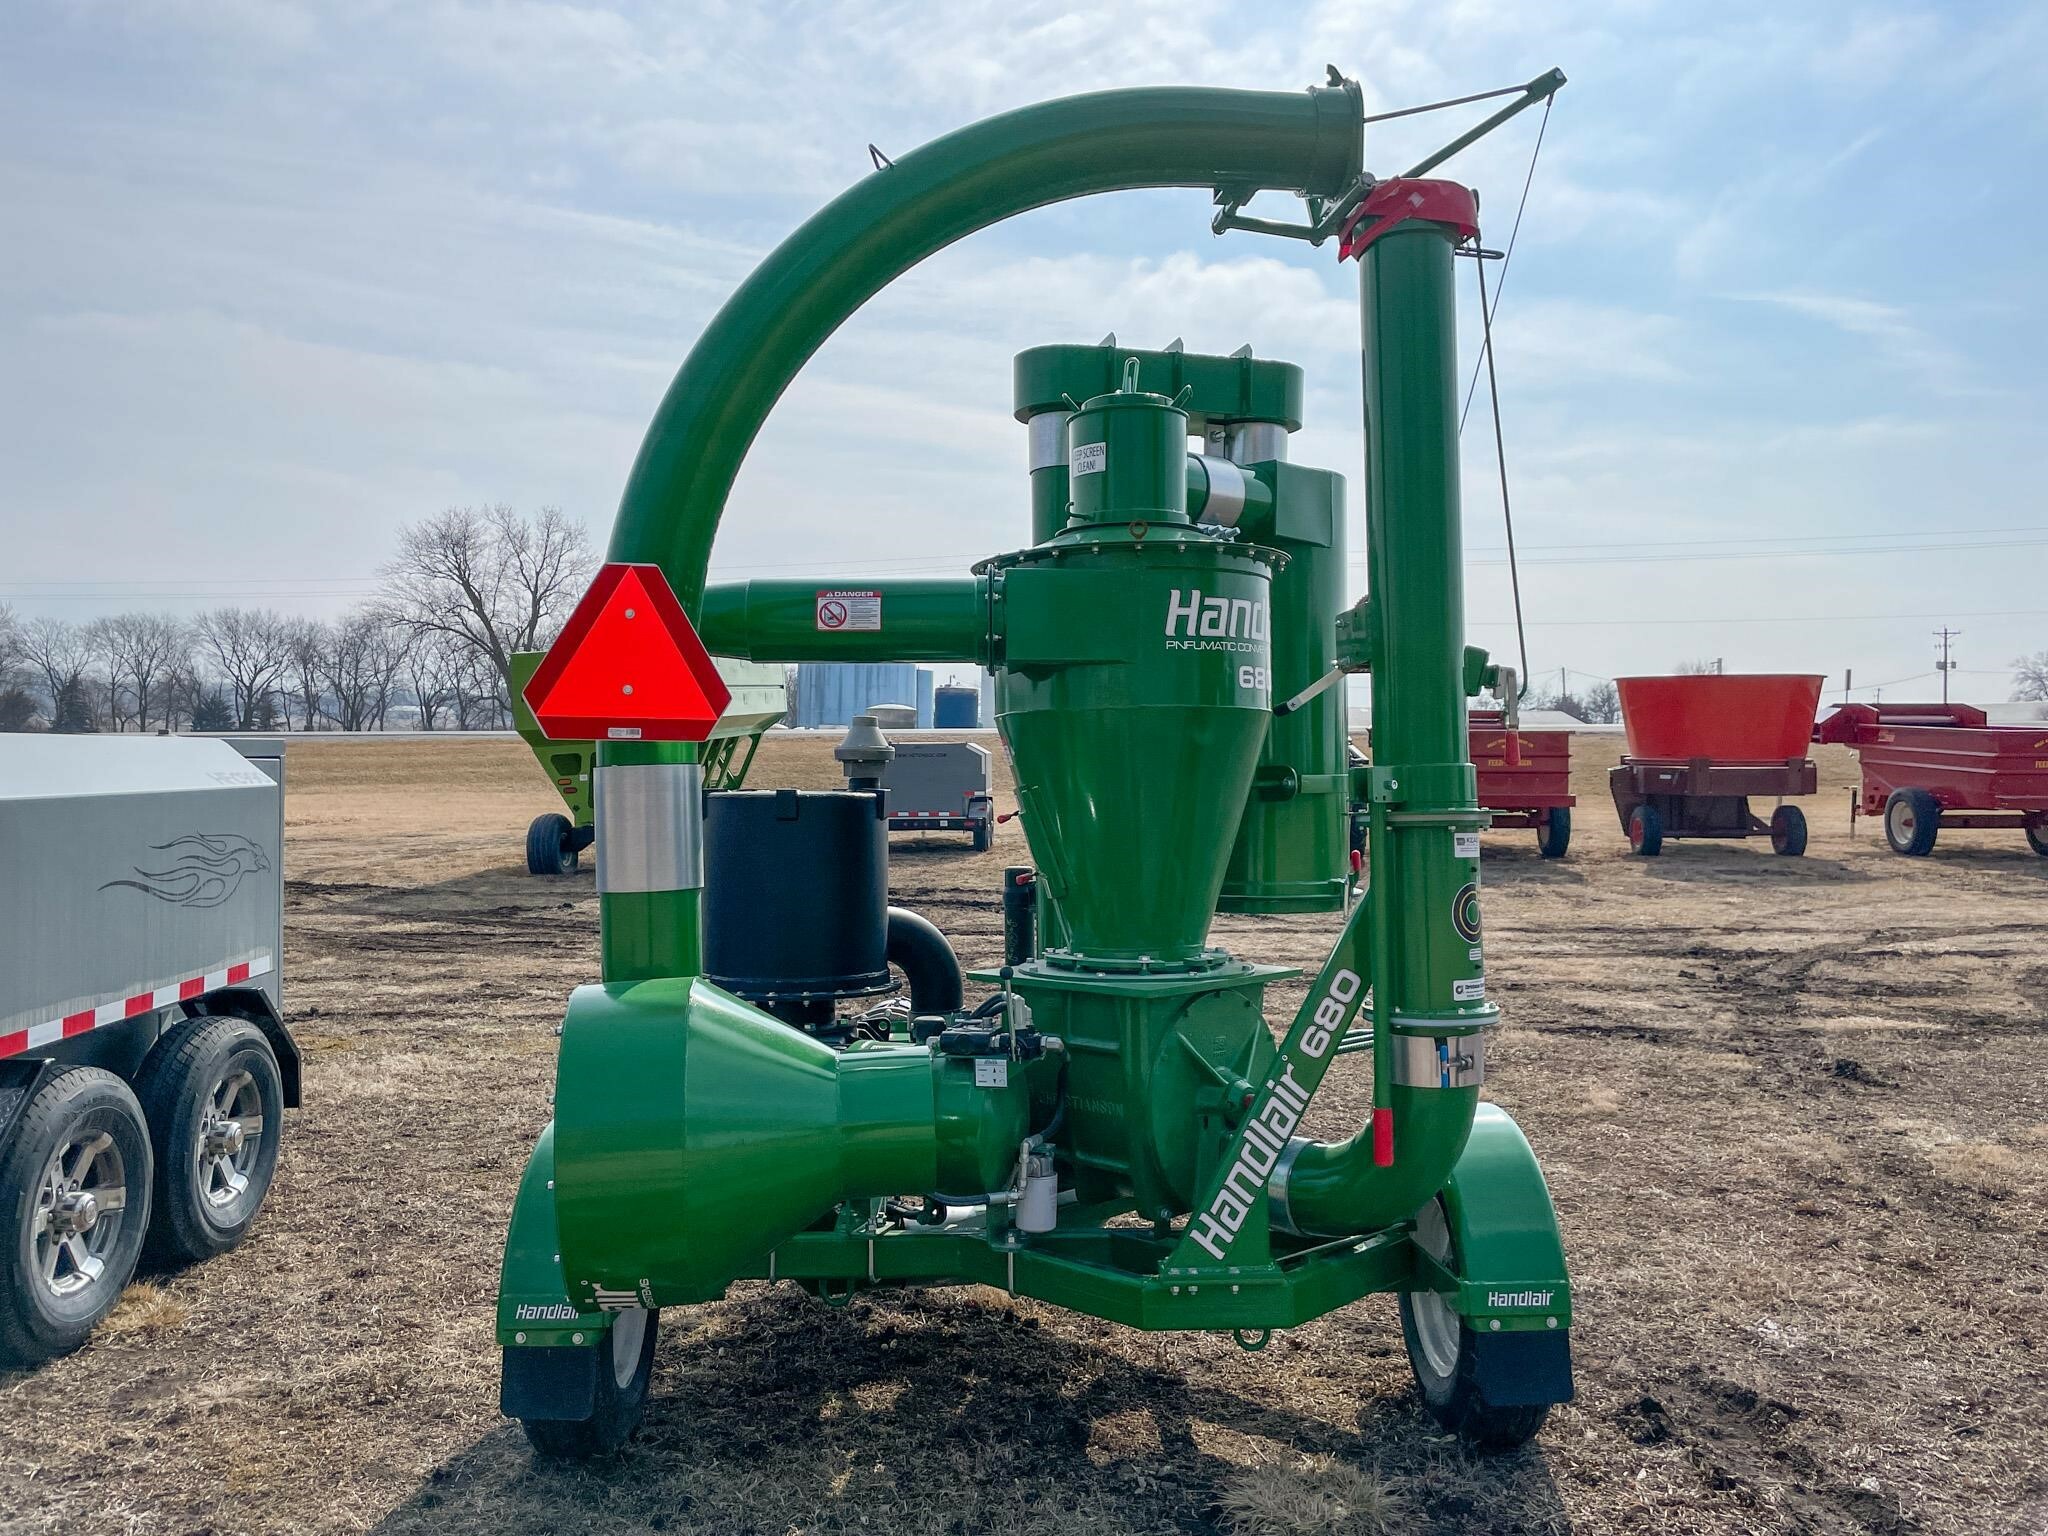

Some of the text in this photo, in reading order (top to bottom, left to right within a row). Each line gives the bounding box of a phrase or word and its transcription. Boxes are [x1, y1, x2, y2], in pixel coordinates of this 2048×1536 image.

[1083, 445, 1105, 459] SCREEN
[1166, 640, 1237, 651] PNEUMATIC
[1239, 665, 1270, 690] 68
[1189, 968, 1362, 1261] Handlair 680
[1488, 1290, 1554, 1307] Handlair
